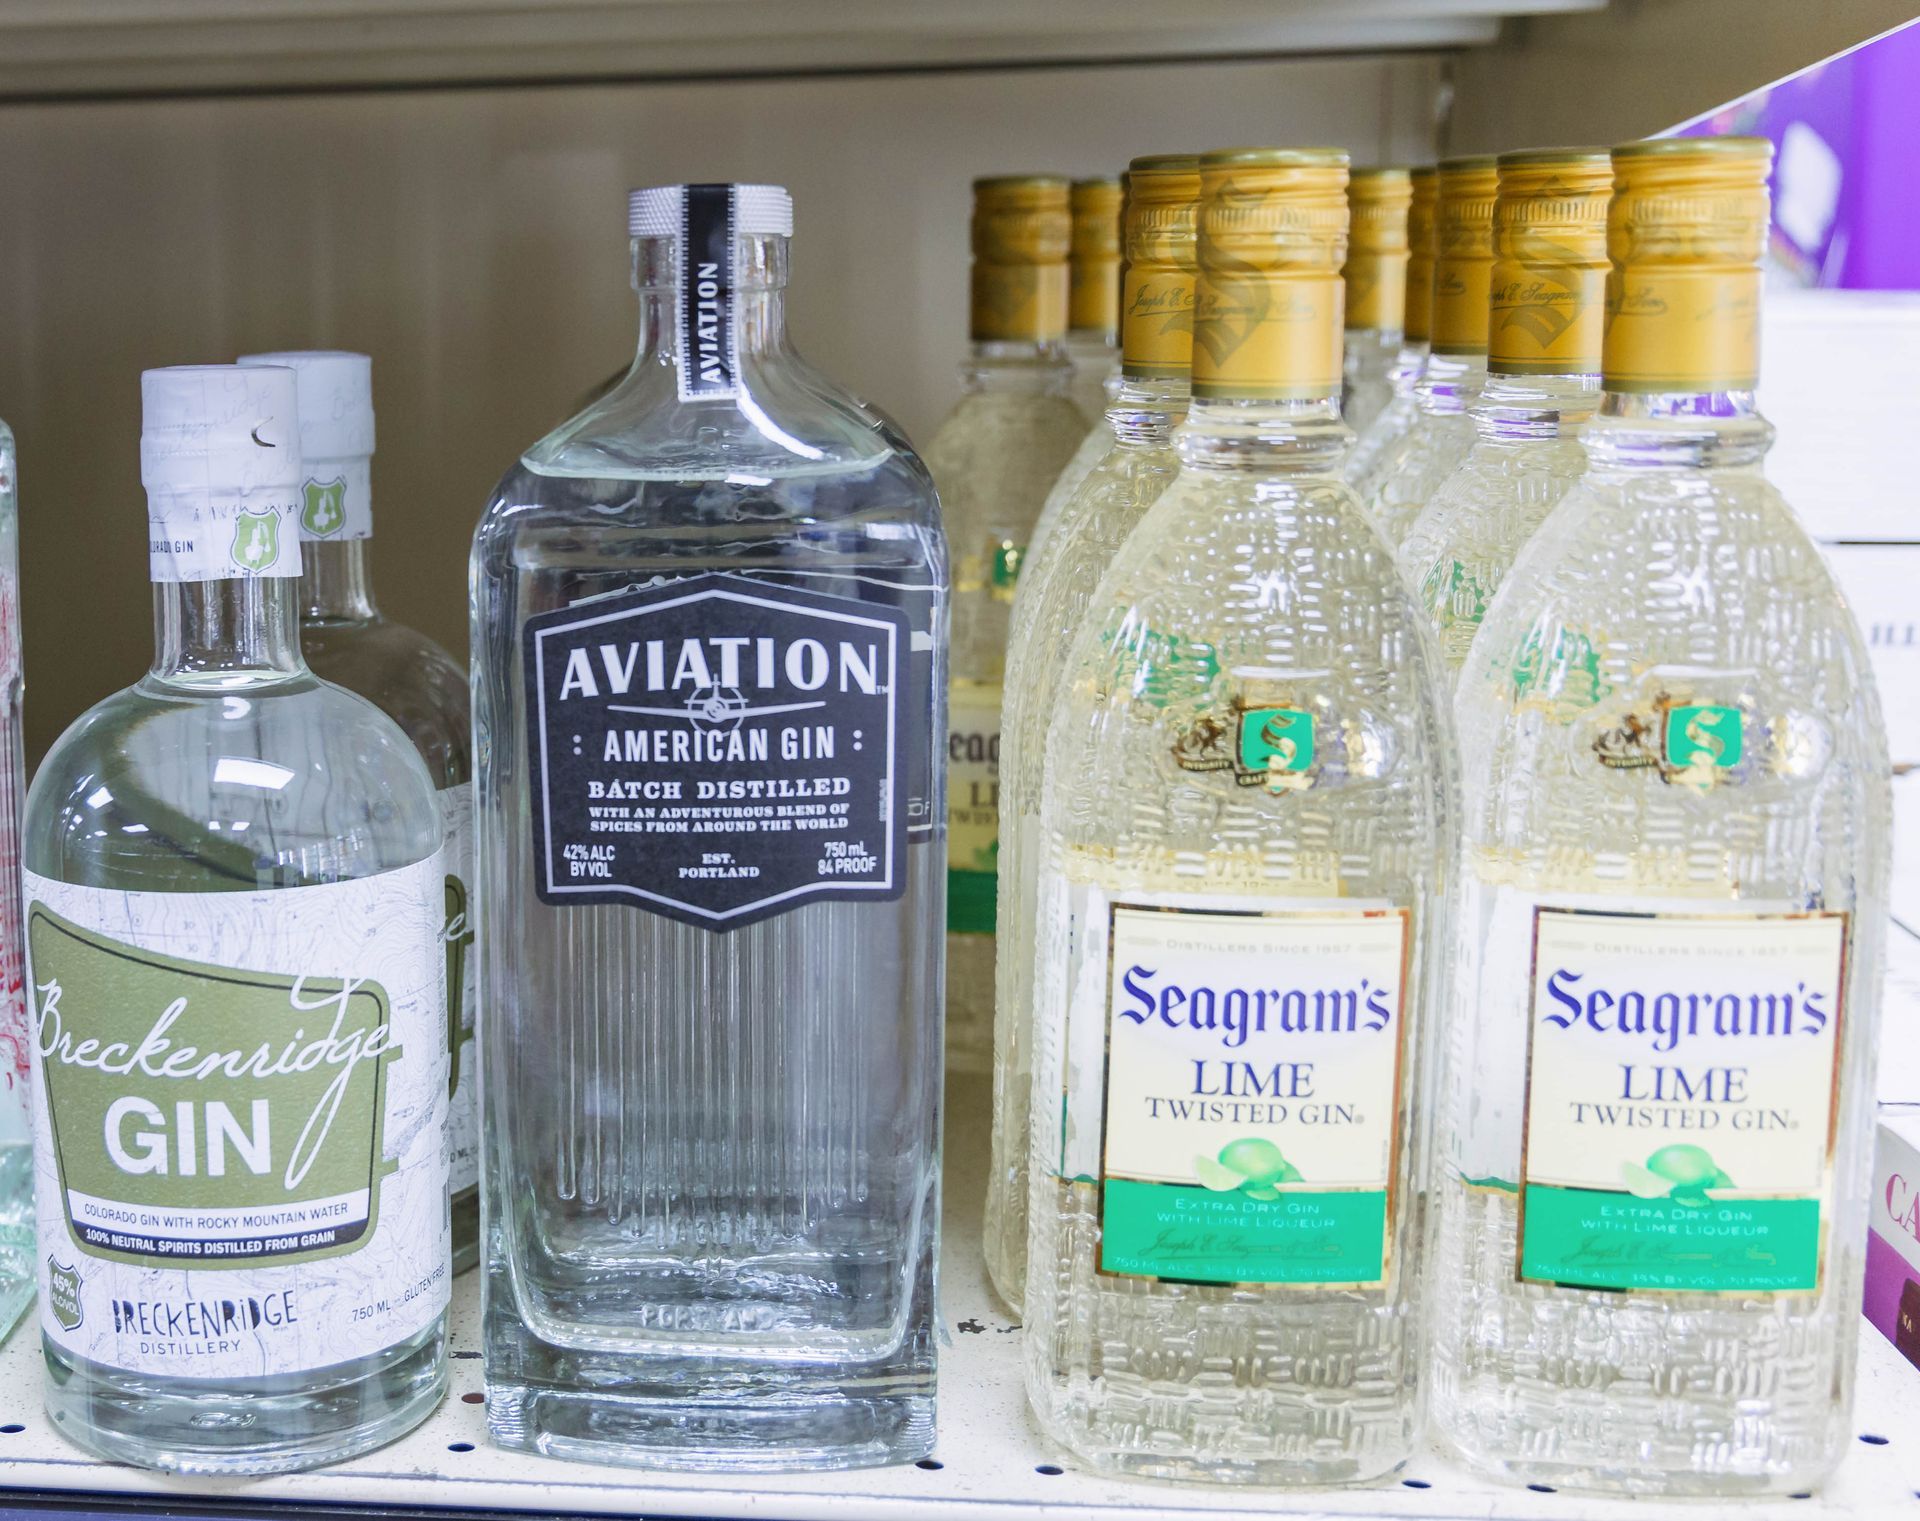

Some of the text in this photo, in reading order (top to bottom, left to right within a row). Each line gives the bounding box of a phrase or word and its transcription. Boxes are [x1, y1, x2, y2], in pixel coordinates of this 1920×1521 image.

[697, 263, 721, 383] AVIATION
[174, 541, 194, 553] GIN
[559, 637, 877, 701] AVIATION
[604, 726, 835, 762] AMERICAN GIN
[588, 777, 851, 799] BATCH DISTILLED
[588, 803, 850, 818] WITH AN ADVENTUROUS BLEND OF
[590, 817, 849, 832] SPICES FROM AROUND THE WORLD
[563, 845, 616, 861] 42% ALC
[701, 853, 735, 865] EST.
[824, 841, 868, 857] 750 mL
[570, 861, 613, 877] BY VOL
[678, 866, 760, 879] PORTLAND
[817, 856, 877, 875] 84 PROOF
[1166, 938, 1258, 954] DISTILLERS
[1263, 941, 1311, 954] SINCE
[1118, 965, 1391, 1048] Seagram's
[1542, 968, 1829, 1052] Seagram's
[36, 976, 400, 1190] Breckenridge
[1191, 1059, 1315, 1098] LIME
[1618, 1064, 1749, 1104] LIME
[1145, 1096, 1355, 1125] TWISTED GIN
[1570, 1101, 1790, 1130] TWISTED GIN
[104, 1096, 272, 1176] GIN
[84, 1203, 348, 1229] COLORADO GIN WITH ROCKY MOUNTAIN WATER
[1175, 1198, 1320, 1215] EXTRA DRY GIN
[1601, 1206, 1753, 1222] EXTRA DRY GIN
[1157, 1212, 1336, 1229] WITH LIME LIQUEUR
[1581, 1220, 1769, 1236] WITH LIME LIQUEUR
[86, 1228, 335, 1254] 100% NEUTRAL SPIRITS DISTILLED FROM GRAIN
[53, 1272, 75, 1298] 45%
[404, 1262, 446, 1302] GLUTEN FREE
[112, 1290, 298, 1338] BRECKENRIDGE
[352, 1299, 392, 1322] 750 ML
[140, 1339, 241, 1355] DISTILLERY
